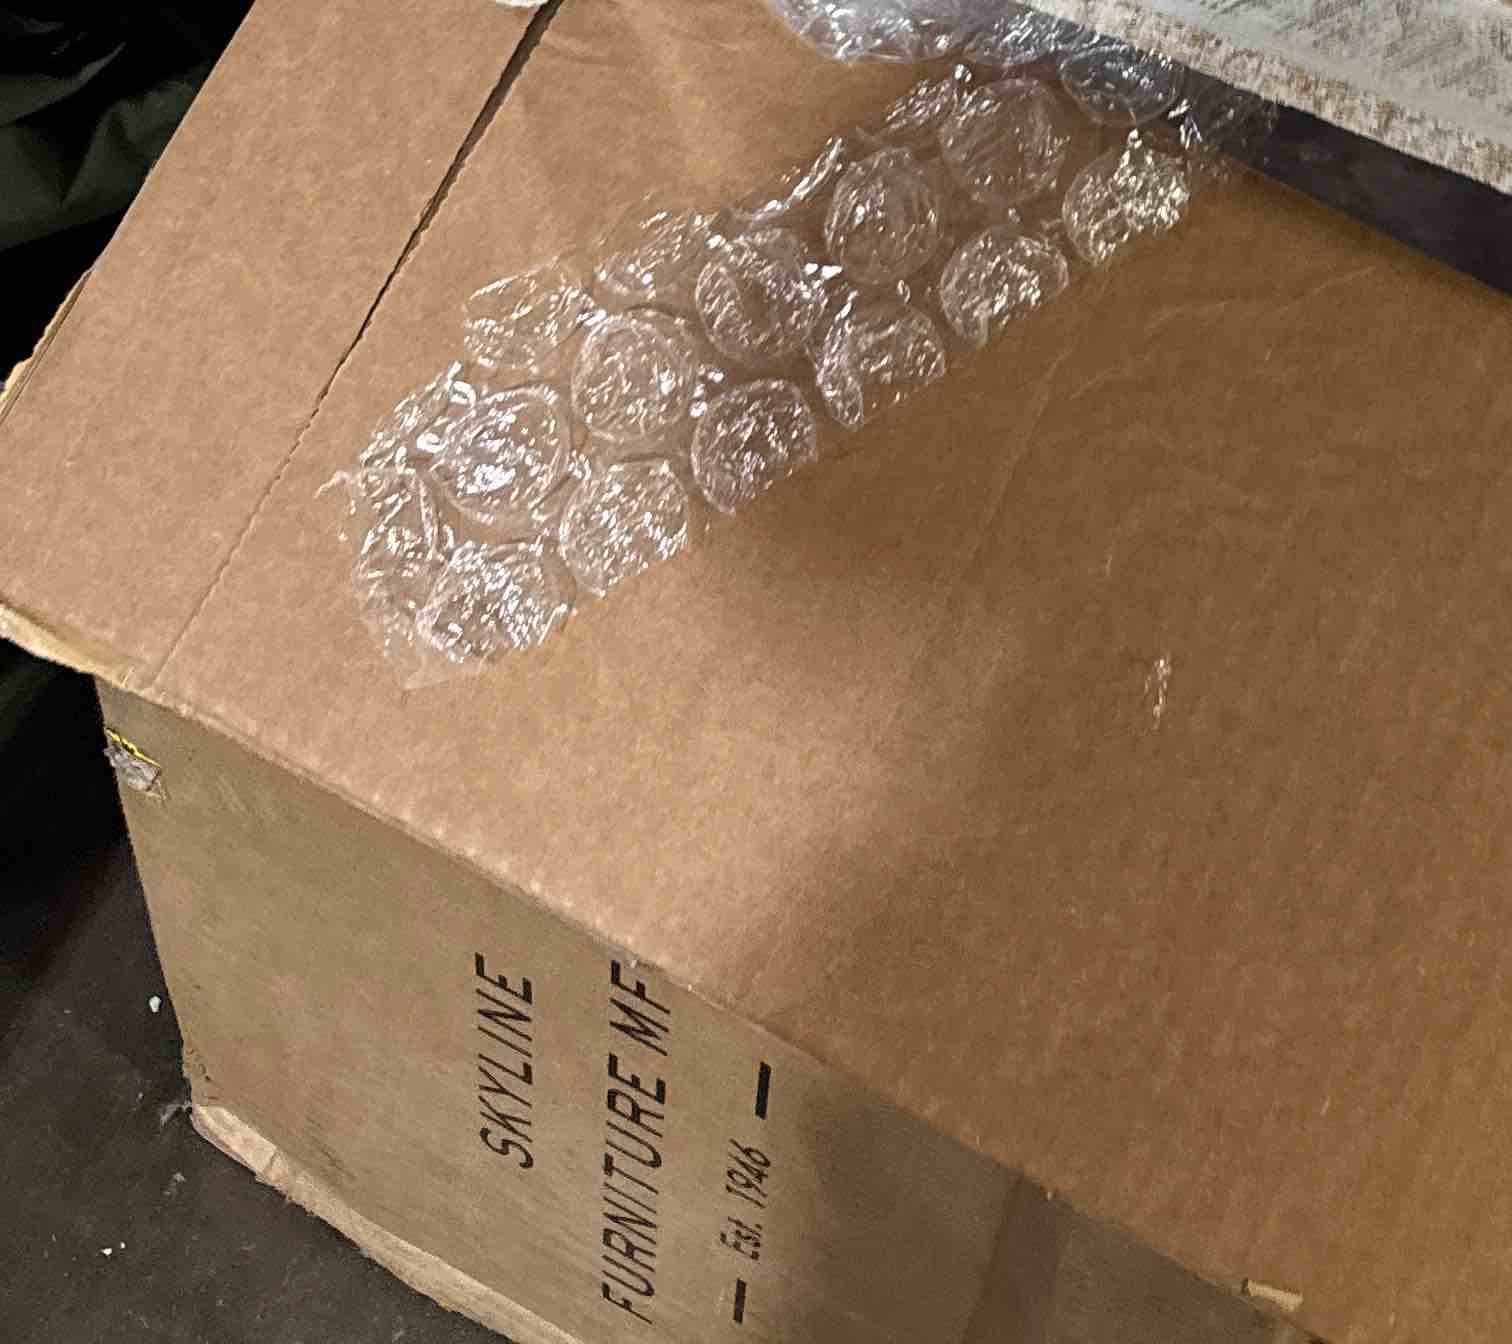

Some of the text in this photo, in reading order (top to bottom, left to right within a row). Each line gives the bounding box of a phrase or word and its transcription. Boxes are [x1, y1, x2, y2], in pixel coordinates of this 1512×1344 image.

[474, 952, 535, 1169] SKYLINE
[601, 1052, 667, 1325] FURNITURE
[719, 1138, 771, 1261] Est. 1946
